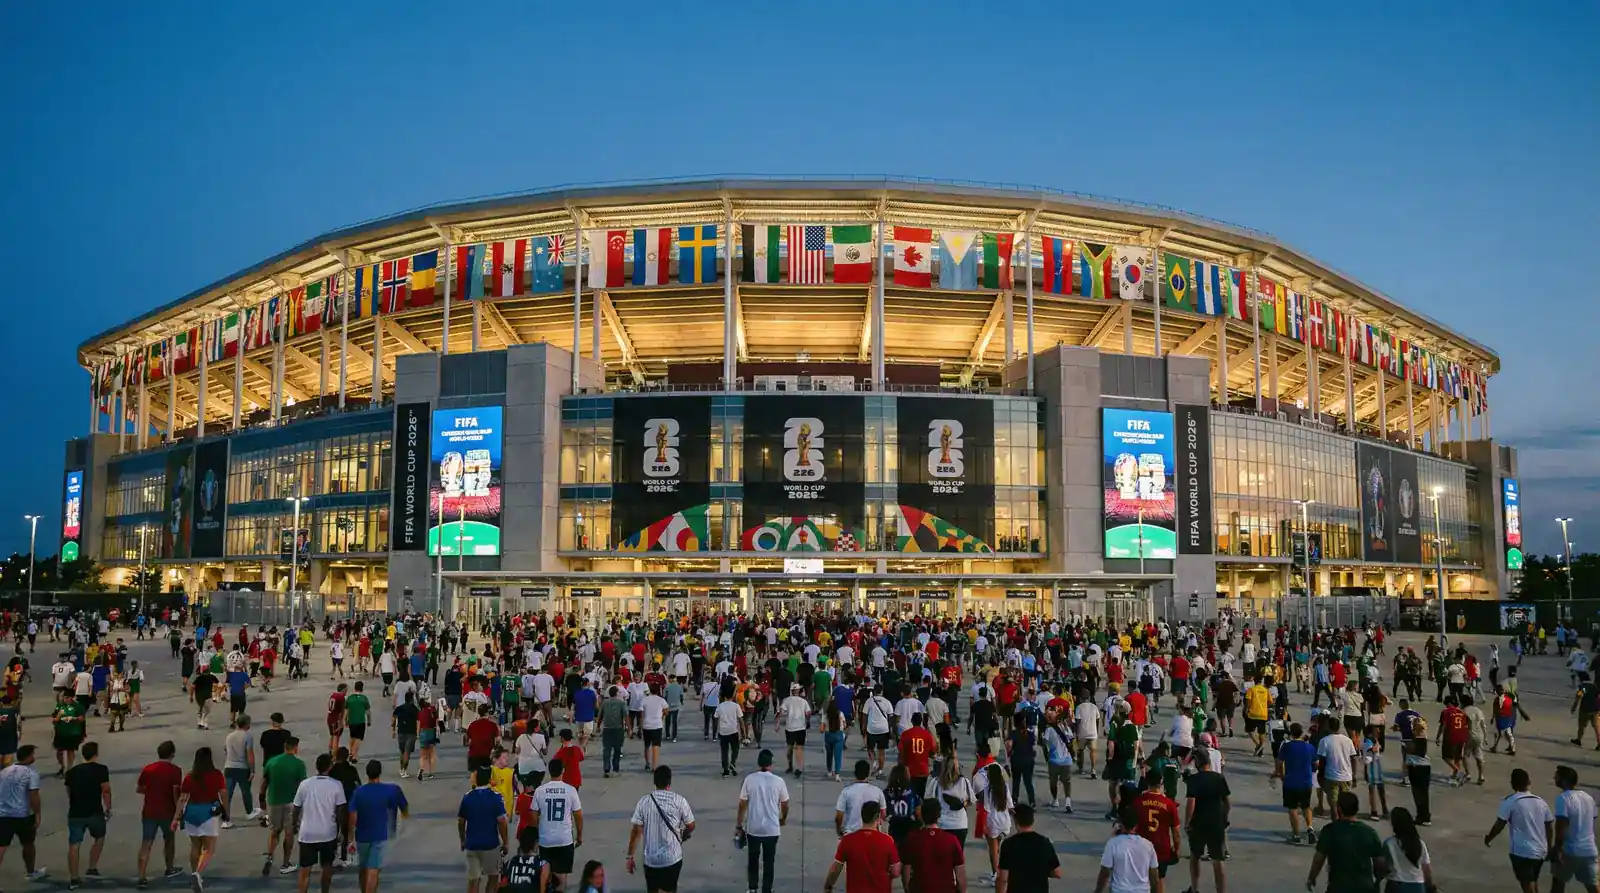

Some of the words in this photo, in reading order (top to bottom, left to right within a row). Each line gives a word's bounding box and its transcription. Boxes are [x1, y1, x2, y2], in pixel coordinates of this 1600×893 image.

[455, 417, 478, 428] FIFA
[1127, 419, 1151, 430] FIFA
[407, 449, 416, 472] CUP
[1188, 452, 1198, 475] CUP
[406, 475, 415, 515] WORLD
[646, 485, 674, 493] 2026
[788, 491, 818, 499] 2026
[1189, 477, 1199, 518] WORLD
[405, 517, 414, 543] FIFA
[1191, 520, 1200, 546] FIFA
[911, 736, 925, 755] 10
[545, 798, 566, 821] 18
[1148, 805, 1160, 832] 5
